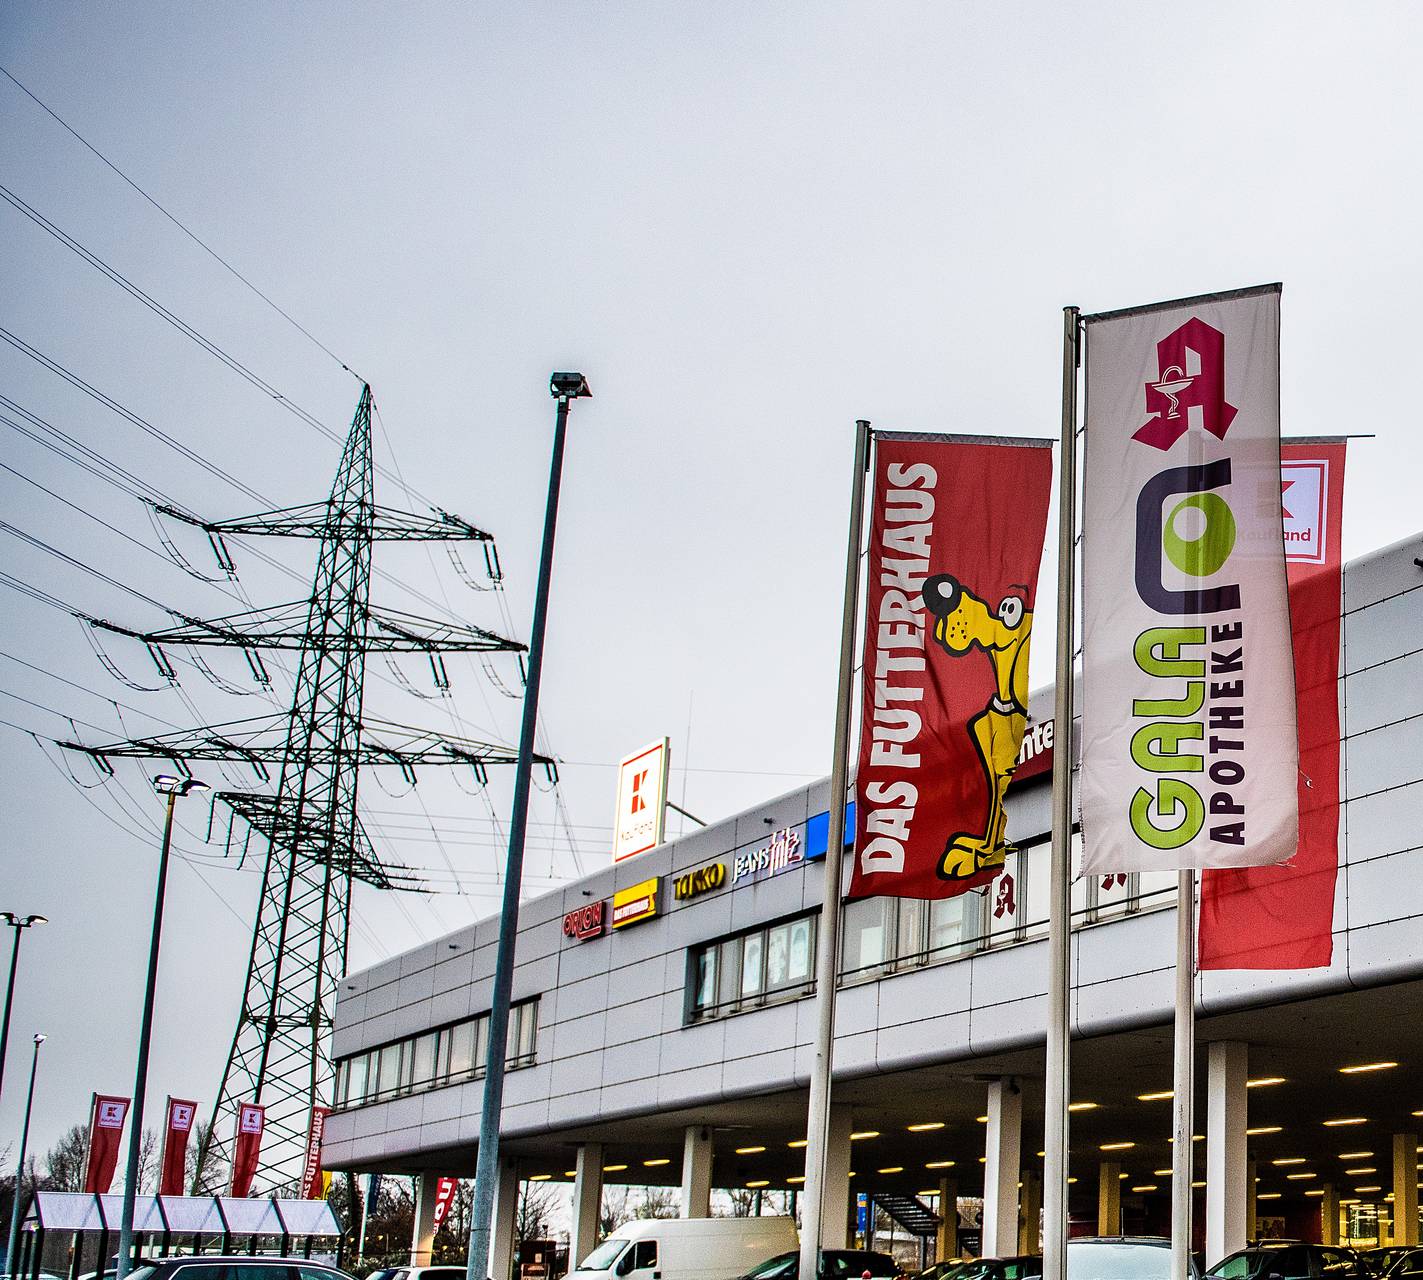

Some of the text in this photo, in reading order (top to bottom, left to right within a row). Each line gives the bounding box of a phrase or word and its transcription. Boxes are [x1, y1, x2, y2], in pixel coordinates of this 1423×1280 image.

[862, 462, 938, 875] DAS FUTTERHAUS
[1129, 626, 1206, 850] GALA
[1209, 621, 1246, 846] APOTHEKE
[563, 901, 606, 941] ORION
[732, 827, 804, 884] JEANS fritz
[306, 1111, 323, 1182] FUTTERHAUS
